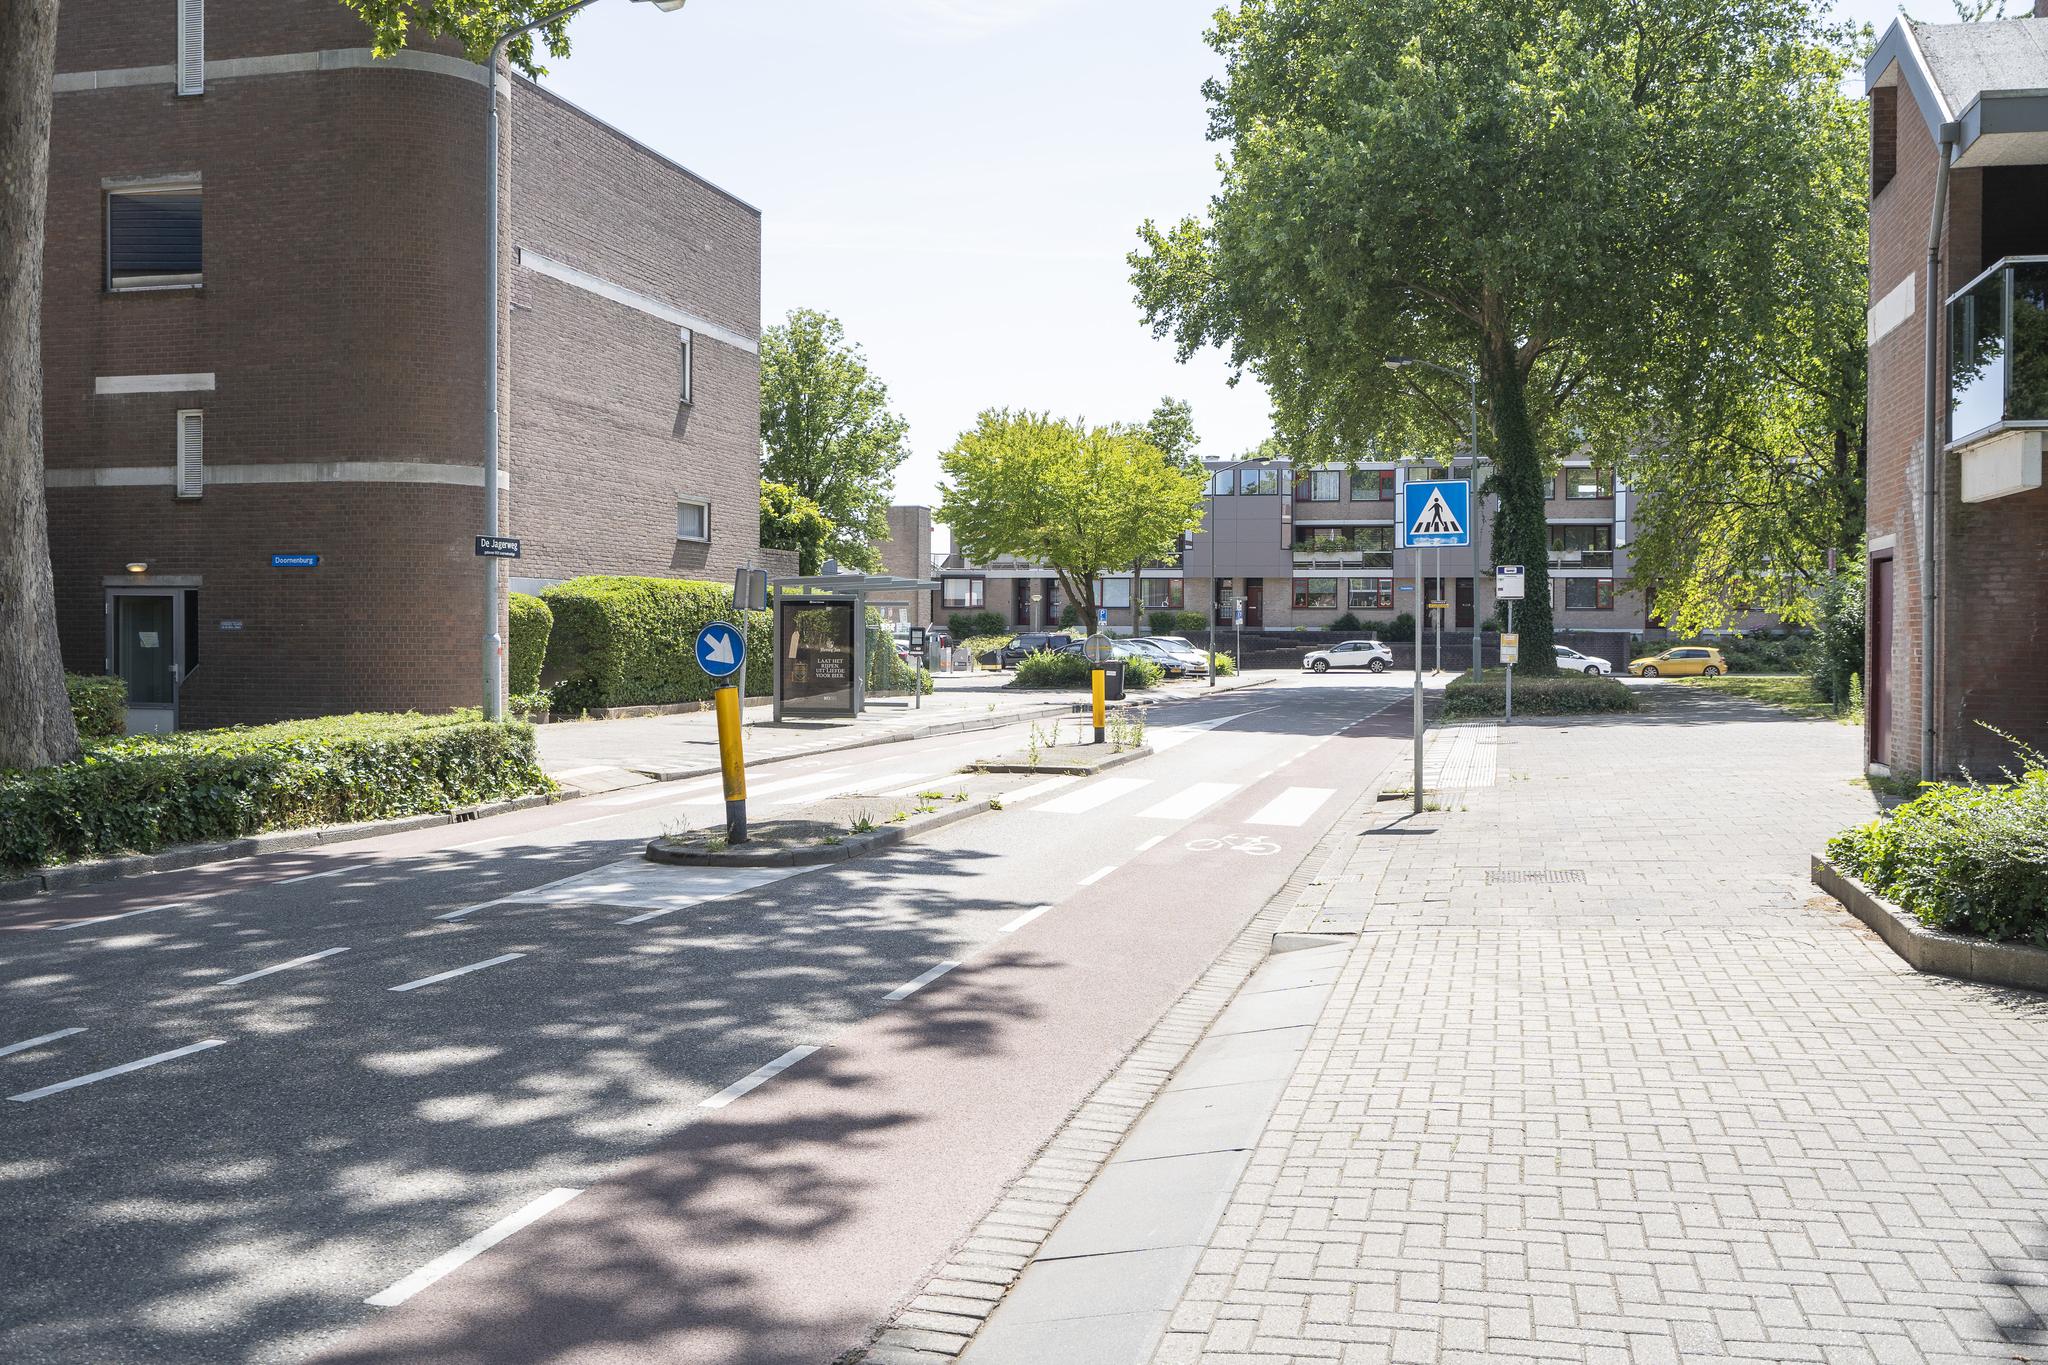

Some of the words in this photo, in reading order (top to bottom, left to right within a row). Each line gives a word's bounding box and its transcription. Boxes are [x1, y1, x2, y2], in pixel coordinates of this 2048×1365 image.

[481, 538, 490, 548] De
[491, 540, 518, 551] Jagerweg
[275, 556, 313, 564] Doornenburg
